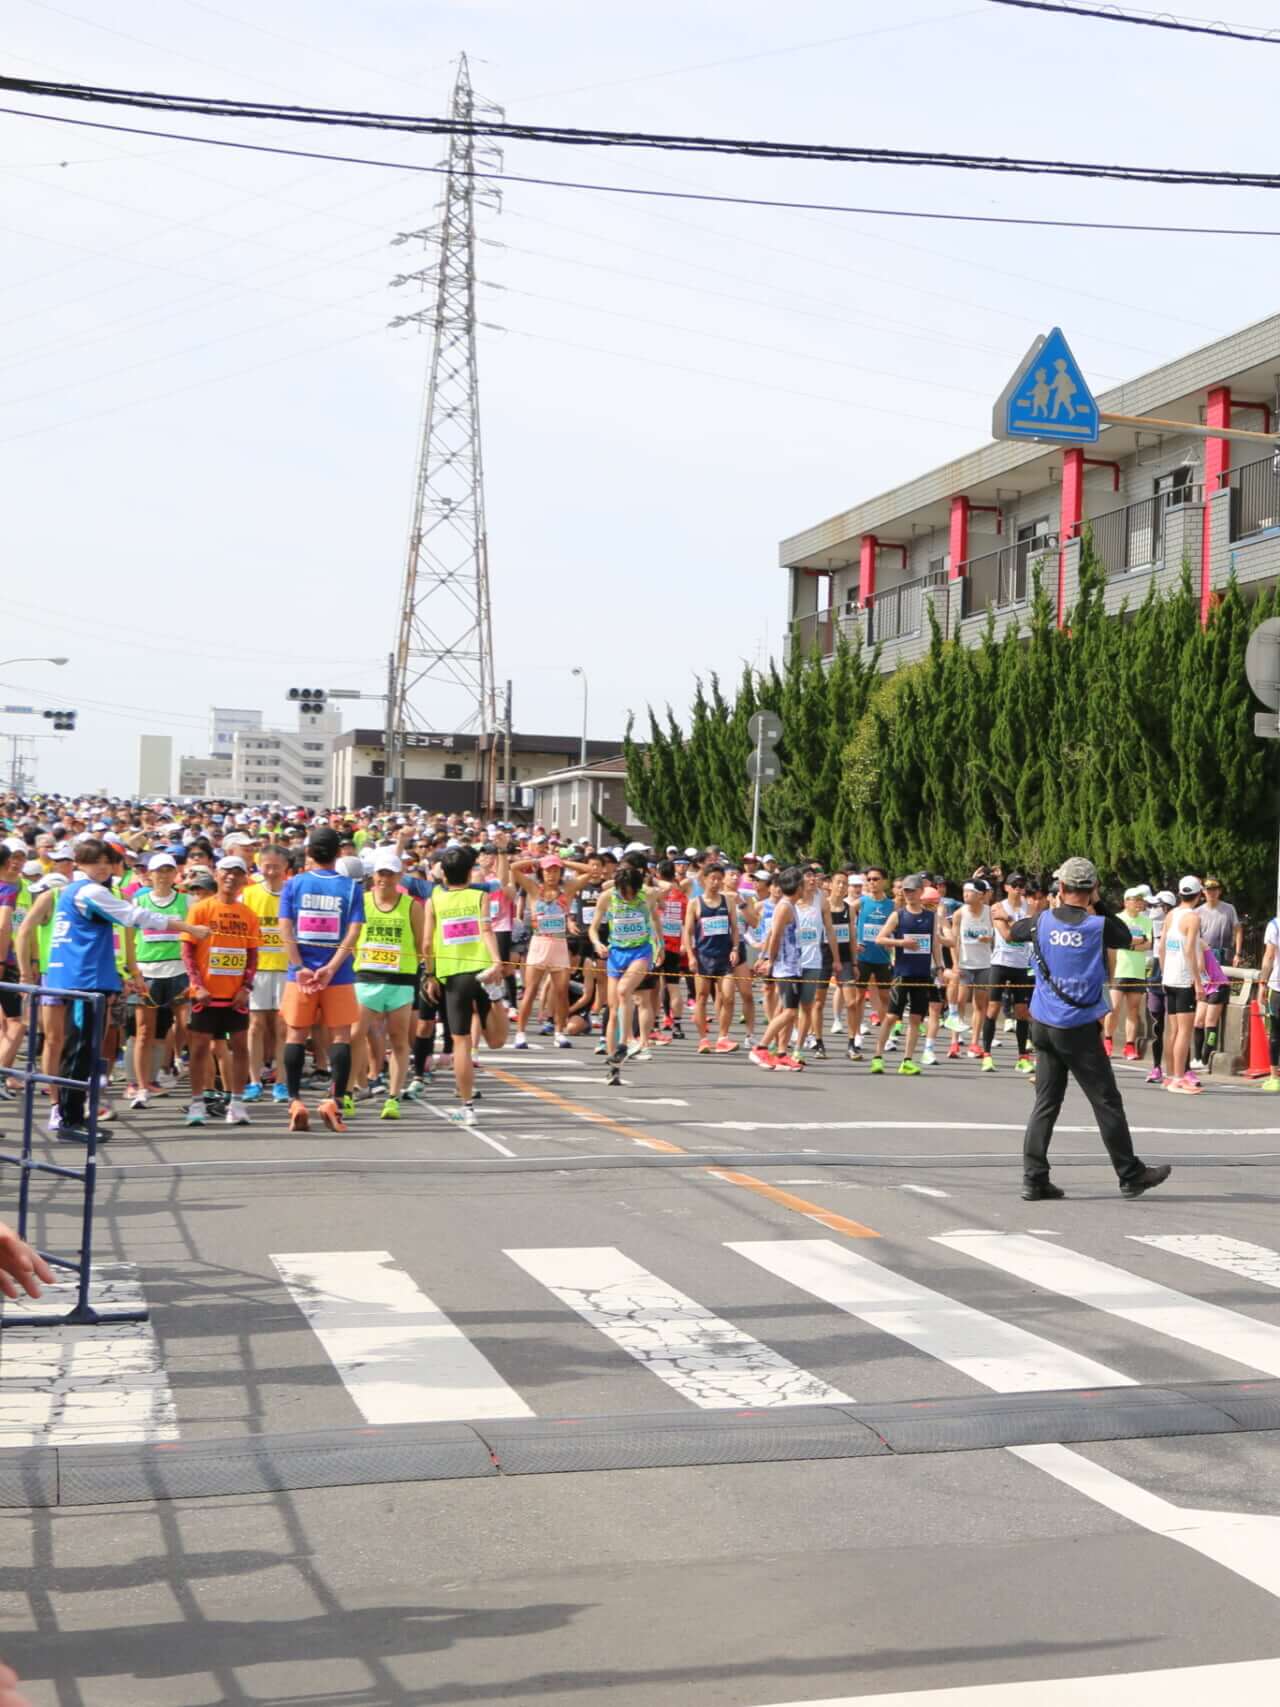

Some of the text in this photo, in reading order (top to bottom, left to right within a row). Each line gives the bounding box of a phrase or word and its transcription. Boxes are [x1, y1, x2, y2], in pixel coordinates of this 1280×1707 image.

[302, 893, 342, 912] GUIDE
[1049, 929, 1083, 948] 303
[371, 950, 398, 962] 235
